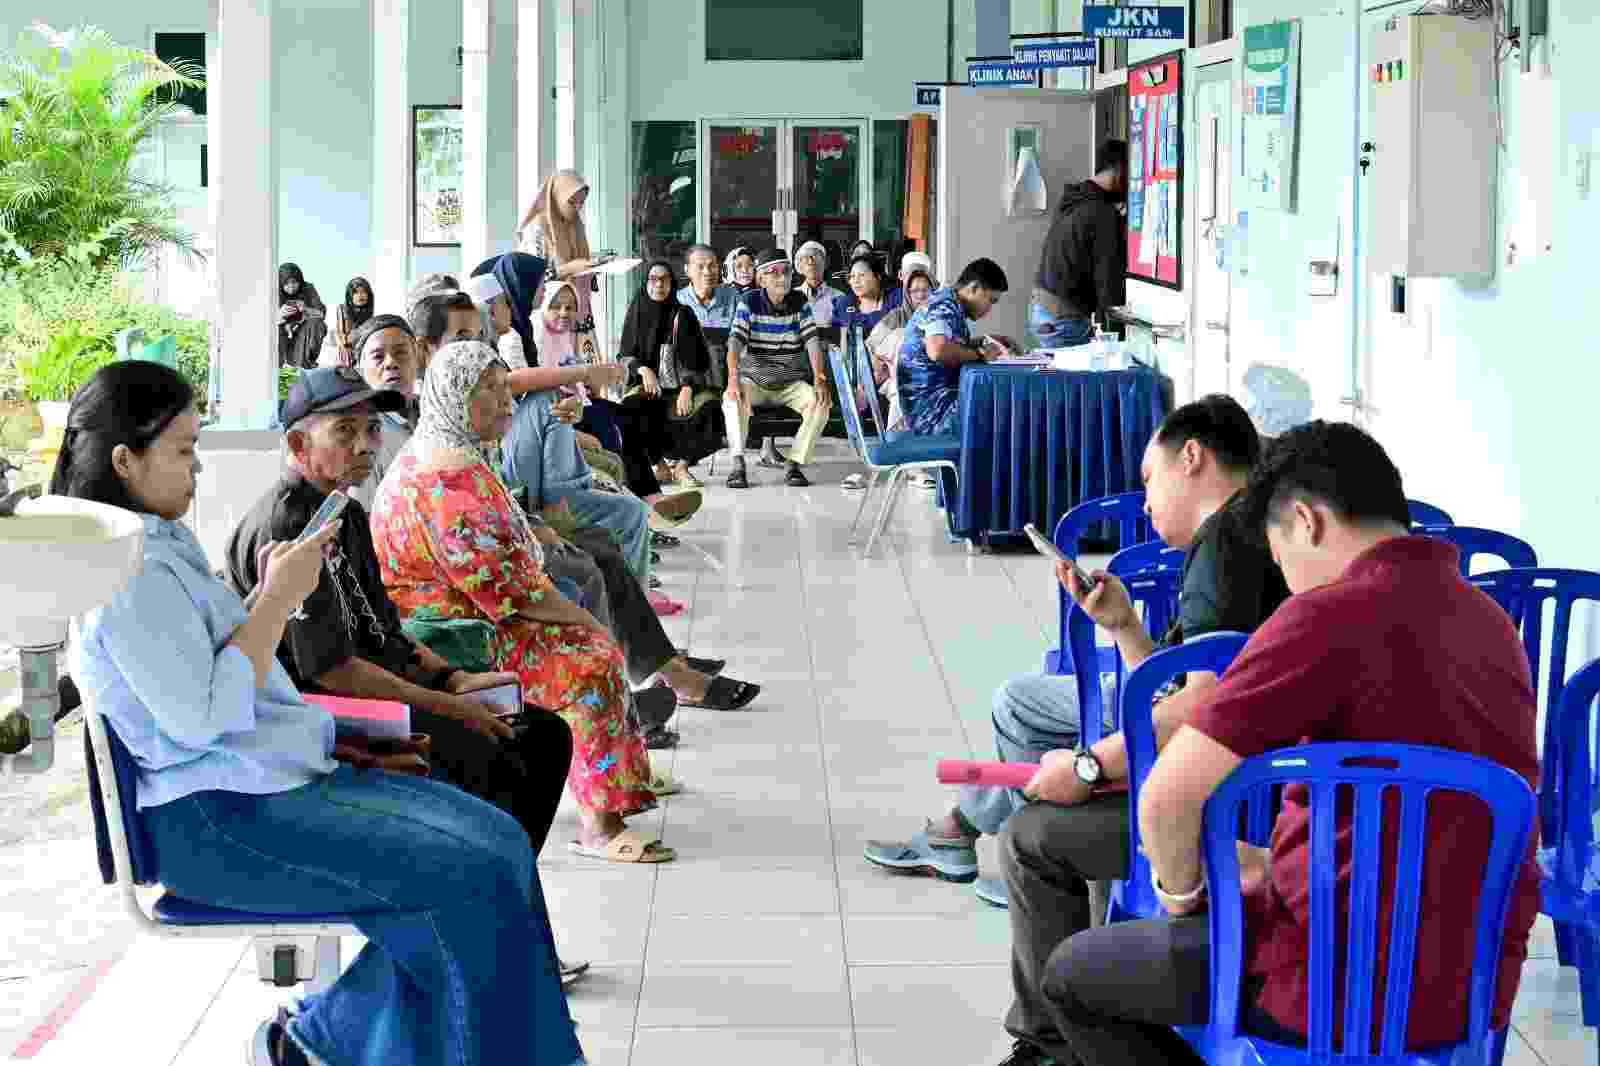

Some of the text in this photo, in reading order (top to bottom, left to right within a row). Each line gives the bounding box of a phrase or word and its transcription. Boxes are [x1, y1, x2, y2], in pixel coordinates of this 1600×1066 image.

[1107, 7, 1159, 26] JKN
[969, 67, 1033, 81] KLINIK ANAK
